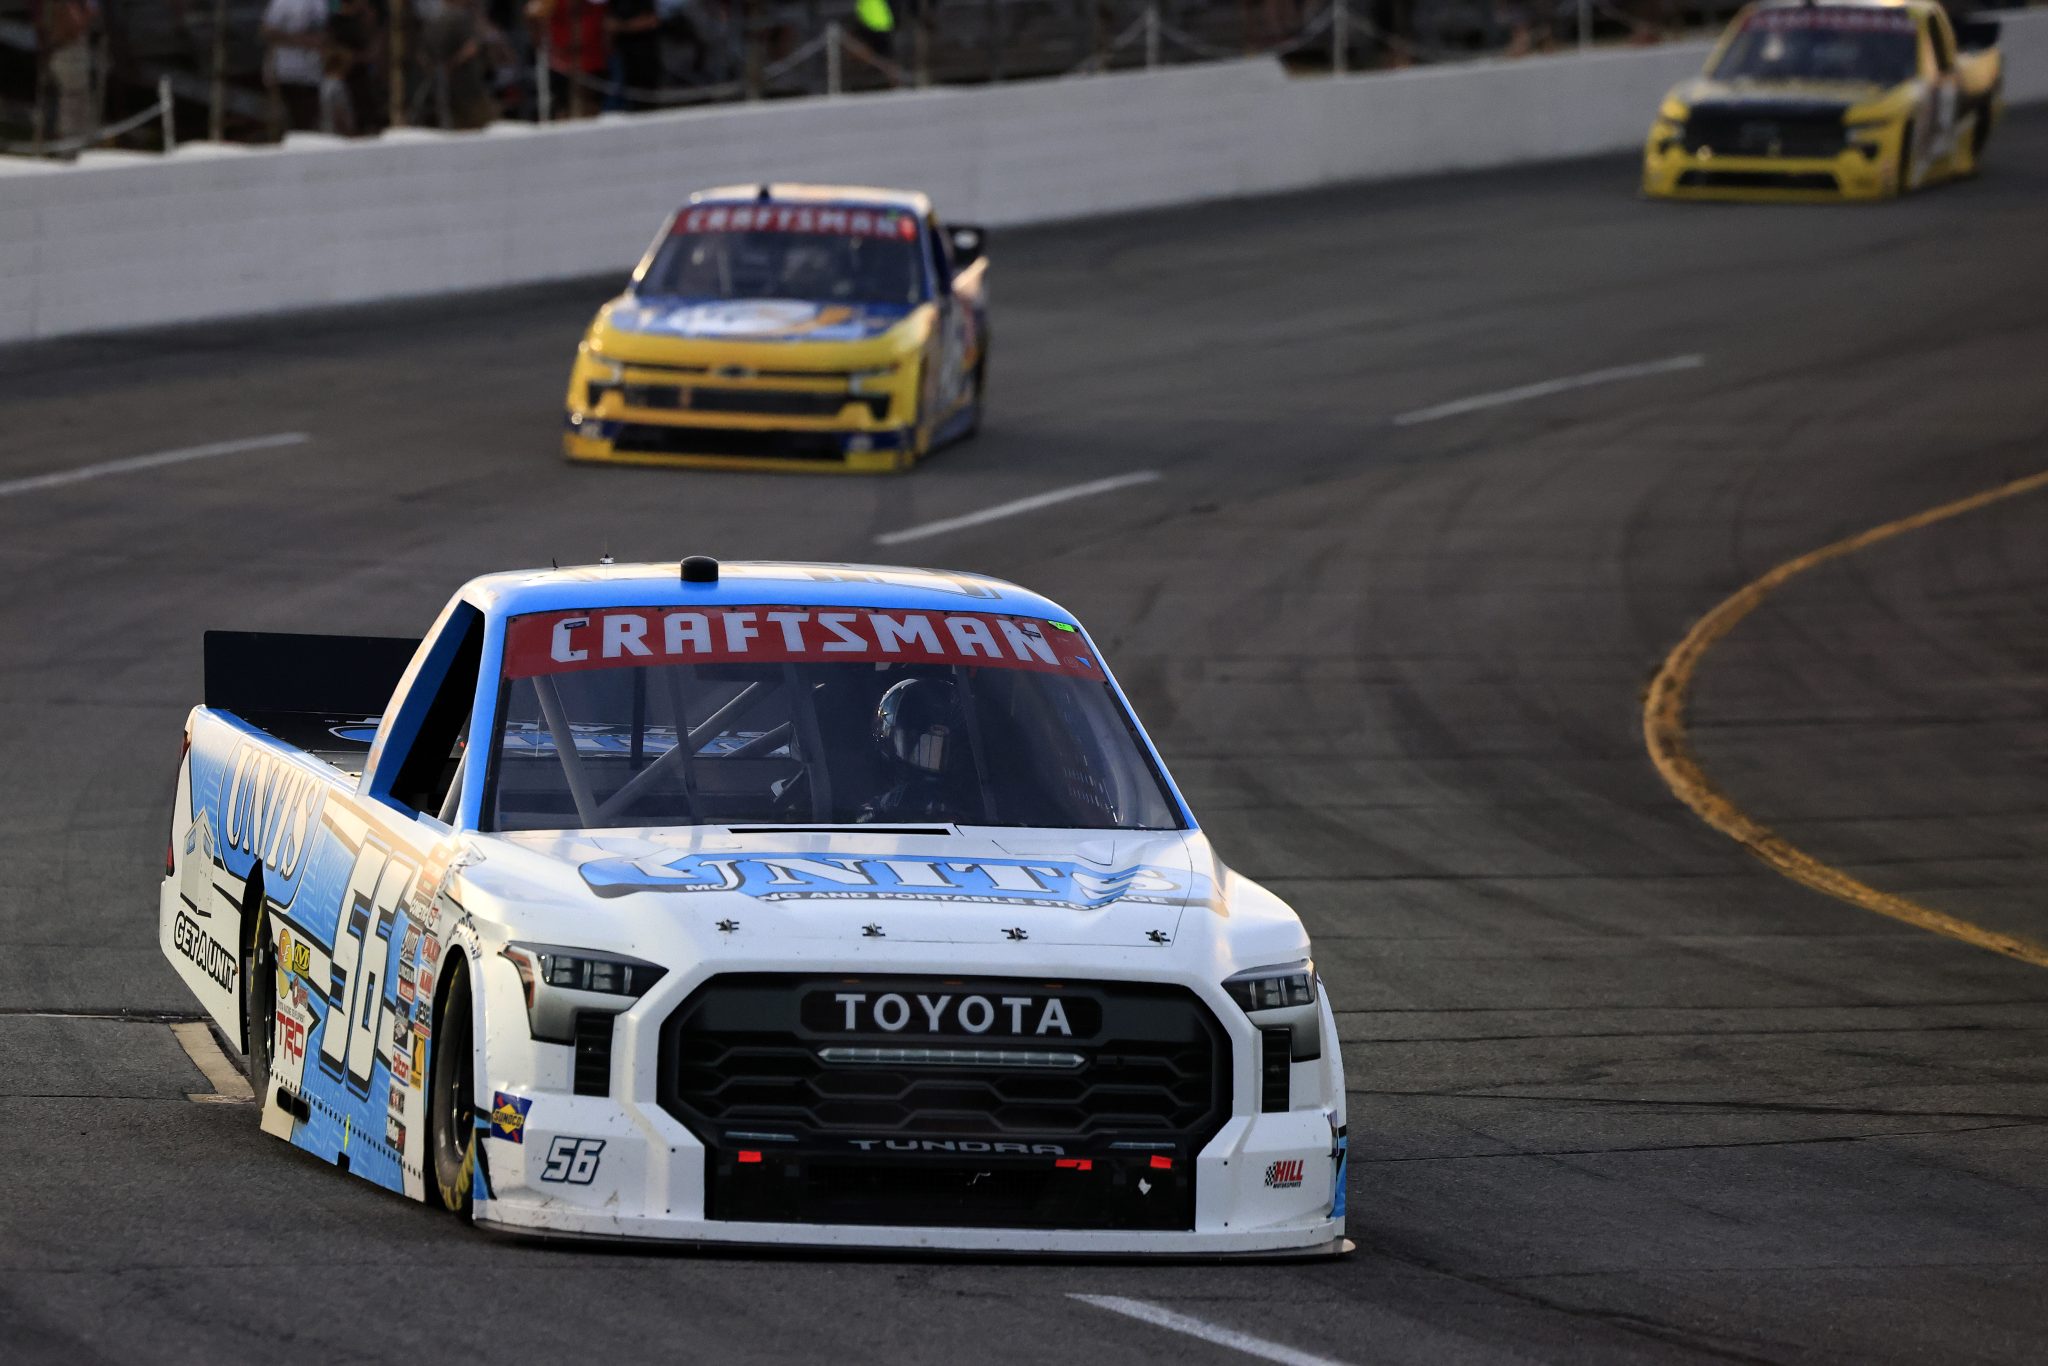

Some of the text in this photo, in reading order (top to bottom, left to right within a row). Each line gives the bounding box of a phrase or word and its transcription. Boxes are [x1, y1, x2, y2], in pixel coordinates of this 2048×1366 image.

[550, 612, 1062, 666] CRAFTSMAN
[226, 743, 322, 882] UNITS
[811, 891, 864, 900] AND
[876, 892, 1027, 906] PORTABLE
[174, 910, 200, 954] GET
[206, 938, 238, 994] UNIT
[319, 832, 419, 1097] 56
[277, 1010, 304, 1066] TRD
[835, 993, 1073, 1035] TOYOTA
[493, 1109, 525, 1129] SUNOCO
[541, 1136, 606, 1185] 56
[848, 1138, 1065, 1155] TUNDRA
[1273, 1160, 1304, 1182] HILL
